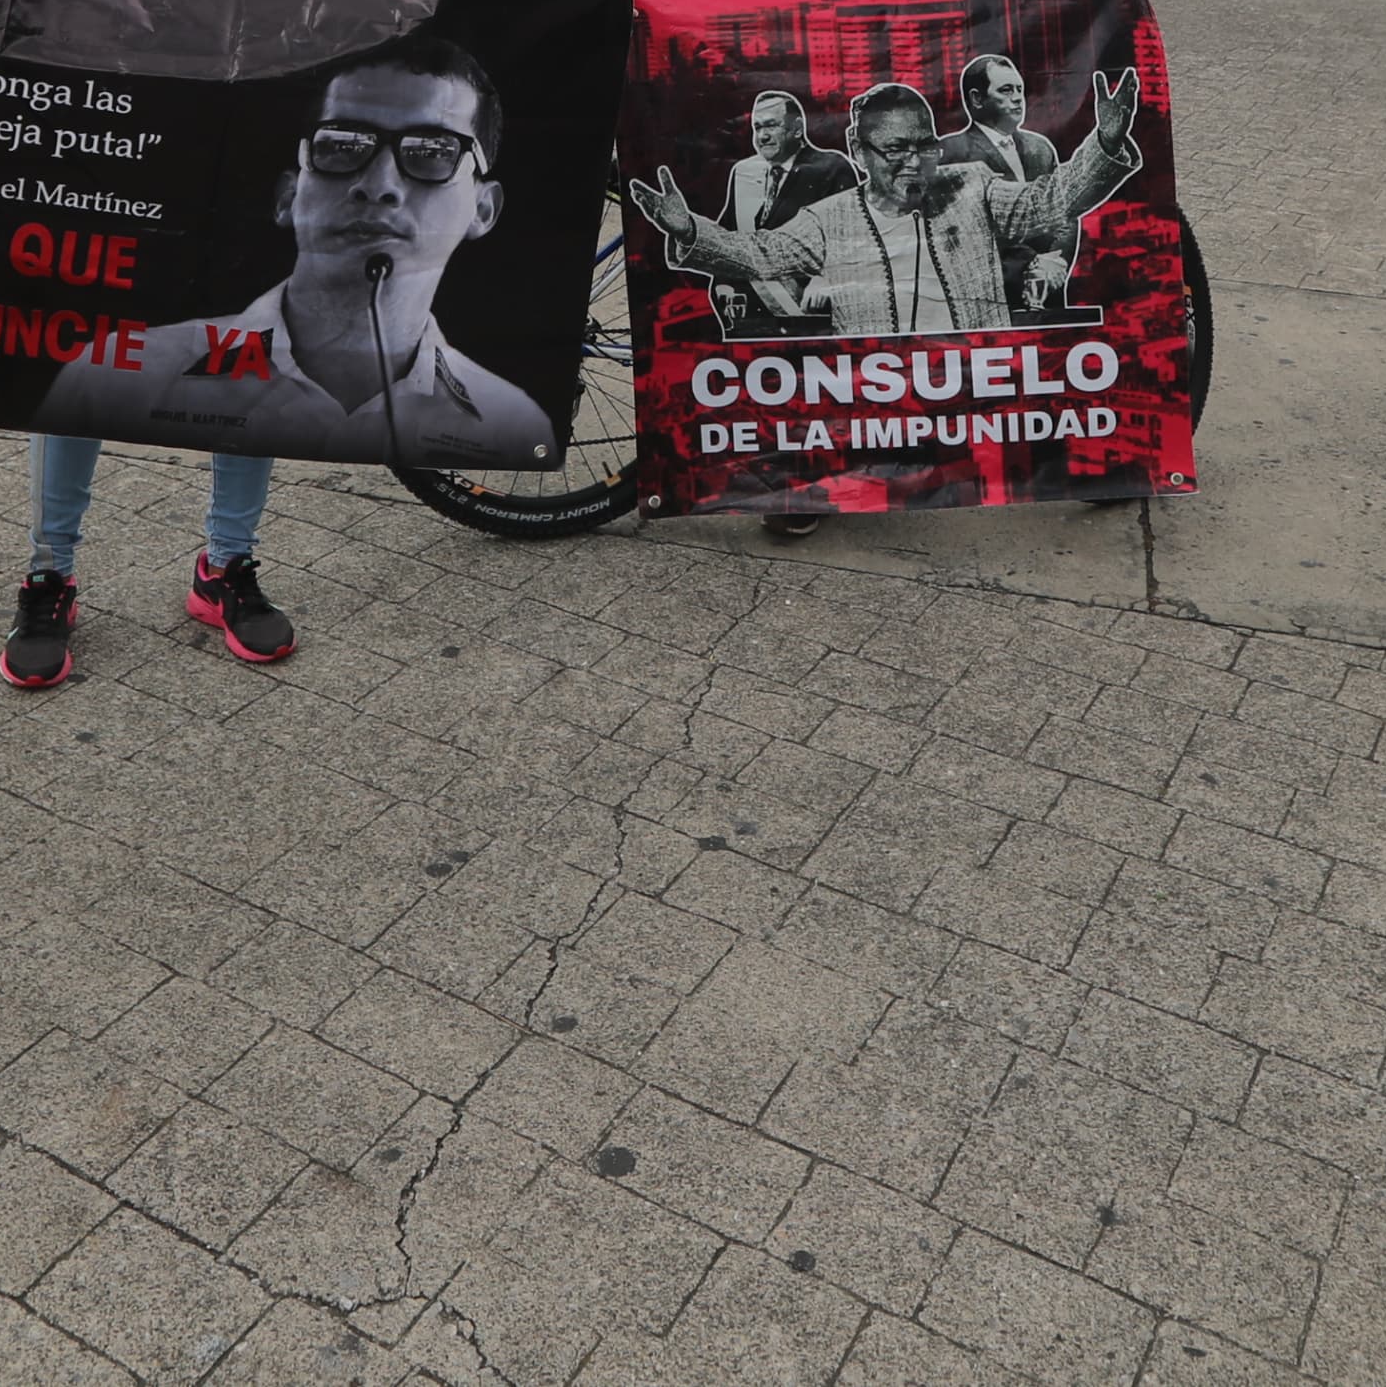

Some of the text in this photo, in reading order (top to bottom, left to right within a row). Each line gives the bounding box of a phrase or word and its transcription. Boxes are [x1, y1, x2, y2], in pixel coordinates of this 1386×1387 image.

[84, 80, 133, 114] las
[34, 179, 164, 220] Martínez
[8, 221, 139, 291] QUE
[203, 323, 272, 382] YA
[691, 341, 1120, 407] CONSUELO
[700, 407, 1117, 454] DE LA IMPUNIDAD
[474, 502, 554, 523] CAMERON
[556, 496, 611, 523] MOUNT
